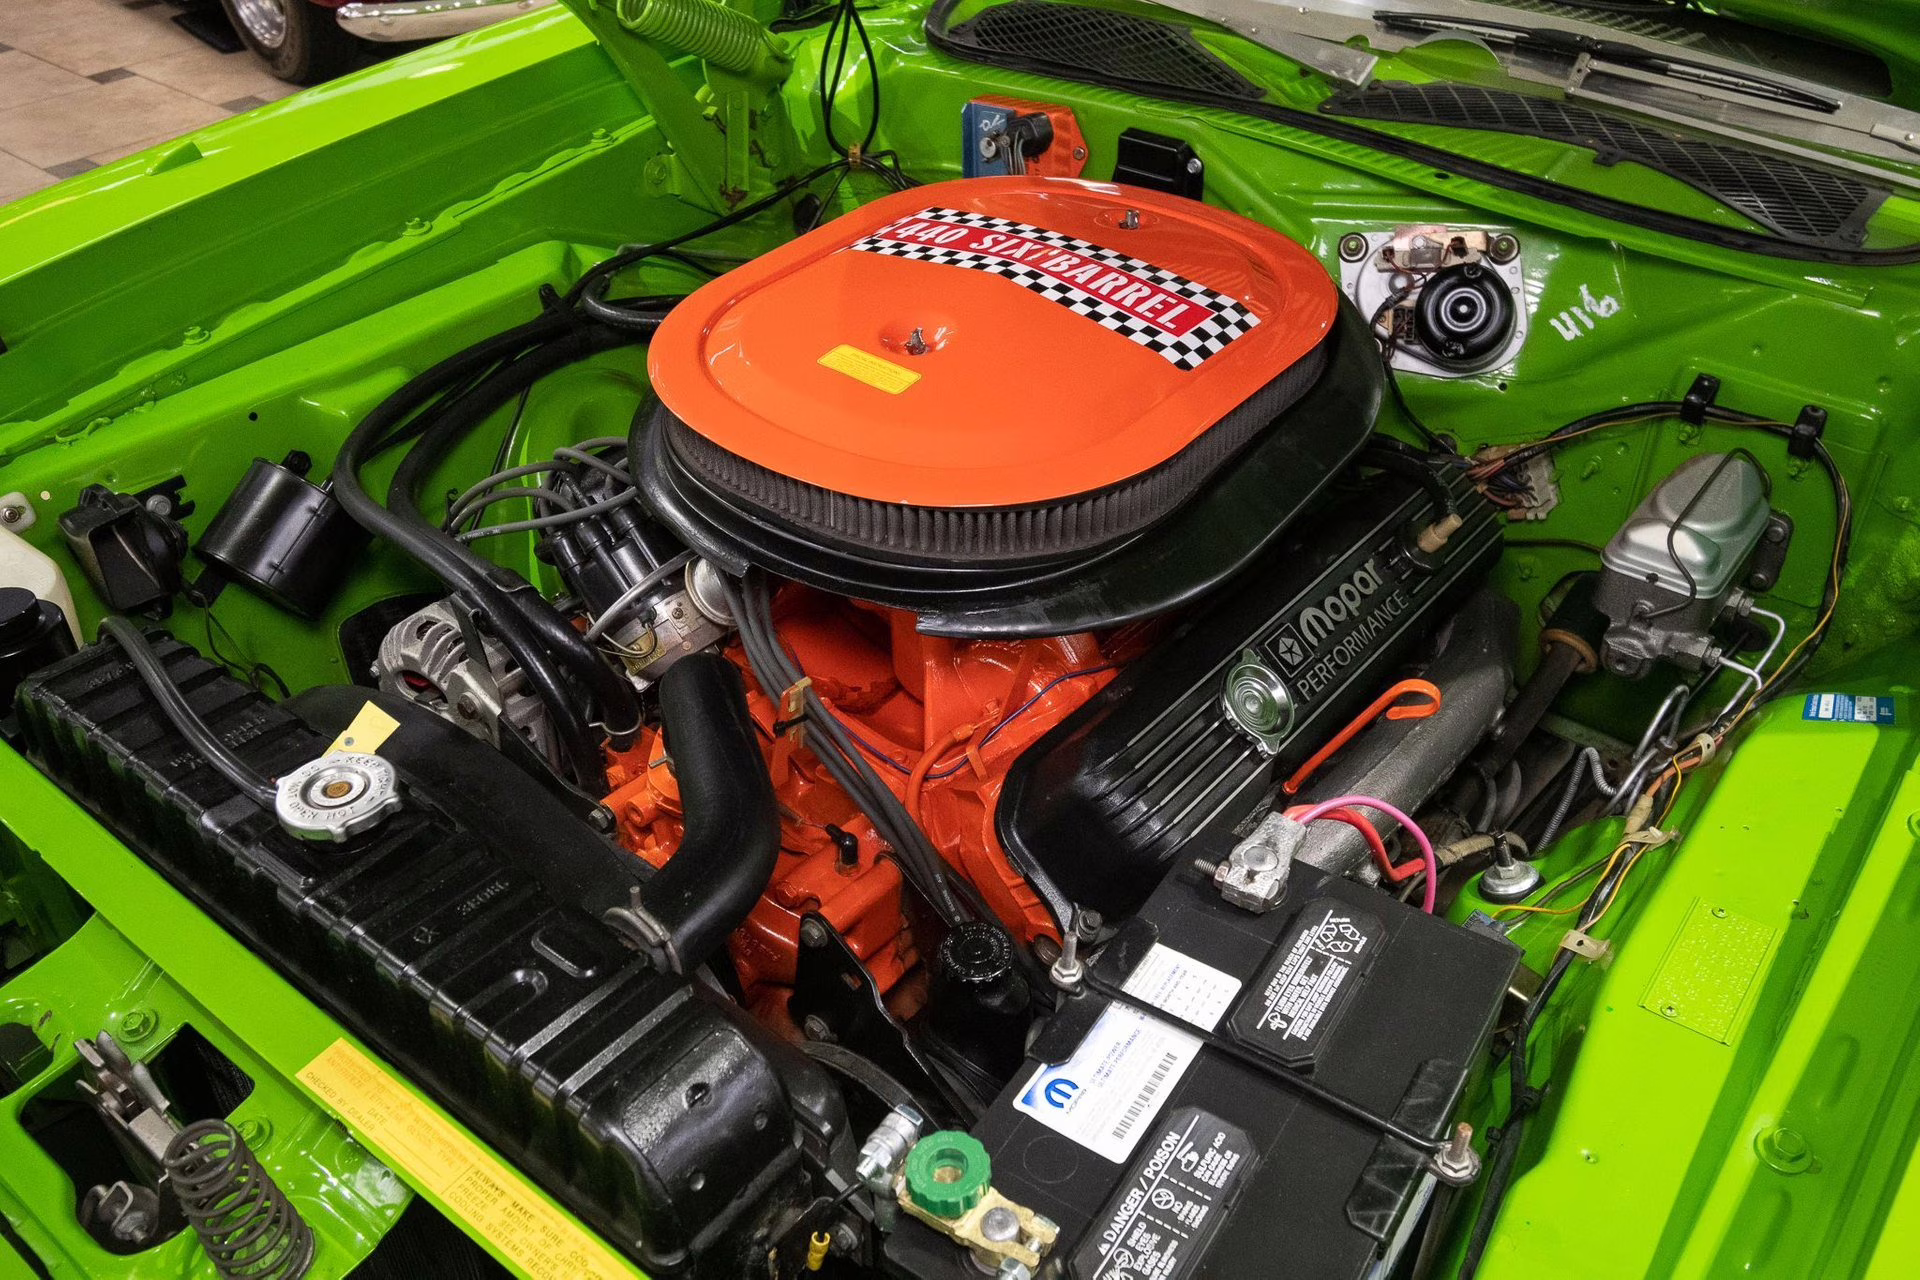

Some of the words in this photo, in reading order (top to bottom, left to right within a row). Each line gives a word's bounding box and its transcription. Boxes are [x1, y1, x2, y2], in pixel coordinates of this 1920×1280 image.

[897, 220, 967, 247] 440
[969, 232, 1037, 261] SIX
[1046, 252, 1192, 331] BARREL
[1299, 559, 1384, 647] Mopar
[1296, 589, 1409, 701] PERFORMANCE
[345, 756, 381, 767] KEEP
[326, 806, 354, 819] HOT
[305, 1071, 337, 1099] CHECKED
[336, 1097, 348, 1107] BY
[346, 1106, 375, 1132] DEALER
[366, 1107, 388, 1126] DATE
[465, 1176, 498, 1206] PROPER
[499, 1206, 535, 1236] AMOUNT
[539, 1239, 552, 1250] OF
[474, 1170, 506, 1197] ALWAYS
[511, 1200, 534, 1221] MAKE
[539, 1225, 564, 1248] SURE
[1103, 1188, 1144, 1242] DANGER
[1143, 1131, 1180, 1179] POISON
[448, 1191, 484, 1223] COOLING
[485, 1222, 525, 1257] SYSTEMS
[498, 1219, 517, 1237] SEE
[519, 1237, 559, 1271] OWNER'S
[1126, 1221, 1147, 1247] SHIELD
[1135, 1232, 1153, 1252] EYES
[1141, 1250, 1161, 1275] GASES
